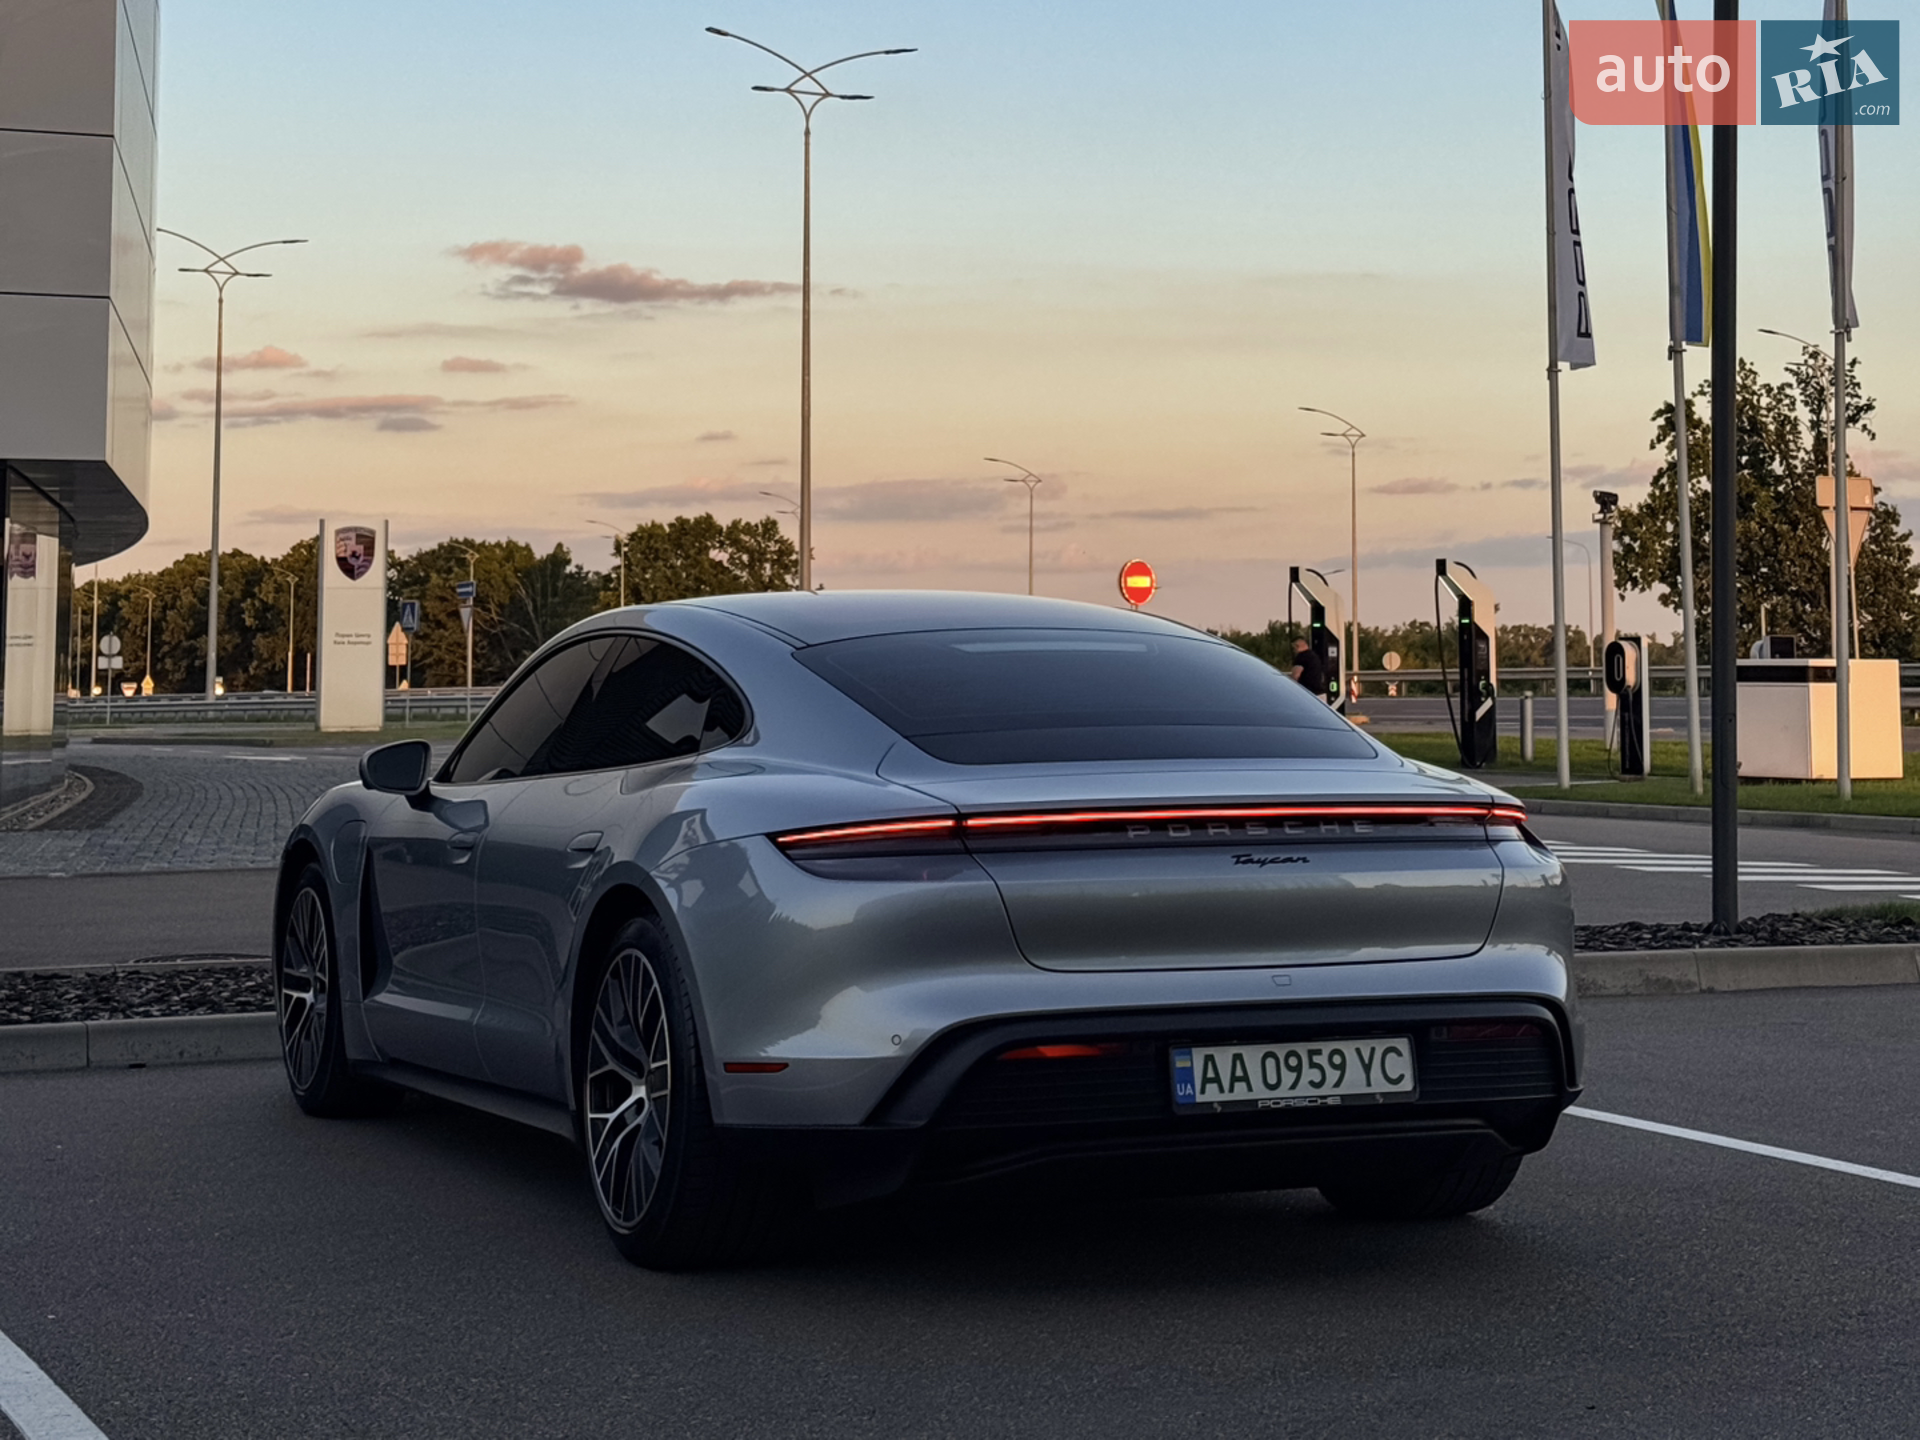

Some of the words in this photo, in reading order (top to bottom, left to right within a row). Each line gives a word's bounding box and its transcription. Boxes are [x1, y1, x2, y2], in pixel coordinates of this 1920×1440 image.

[1126, 820, 1374, 839] PORSCHE
[1231, 853, 1310, 868] Taycan
[1199, 1052, 1254, 1096] AA
[1260, 1048, 1347, 1092] 0959
[1354, 1046, 1406, 1088] YC
[1176, 1083, 1194, 1096] UA
[1257, 1096, 1342, 1109] PORSCHE
